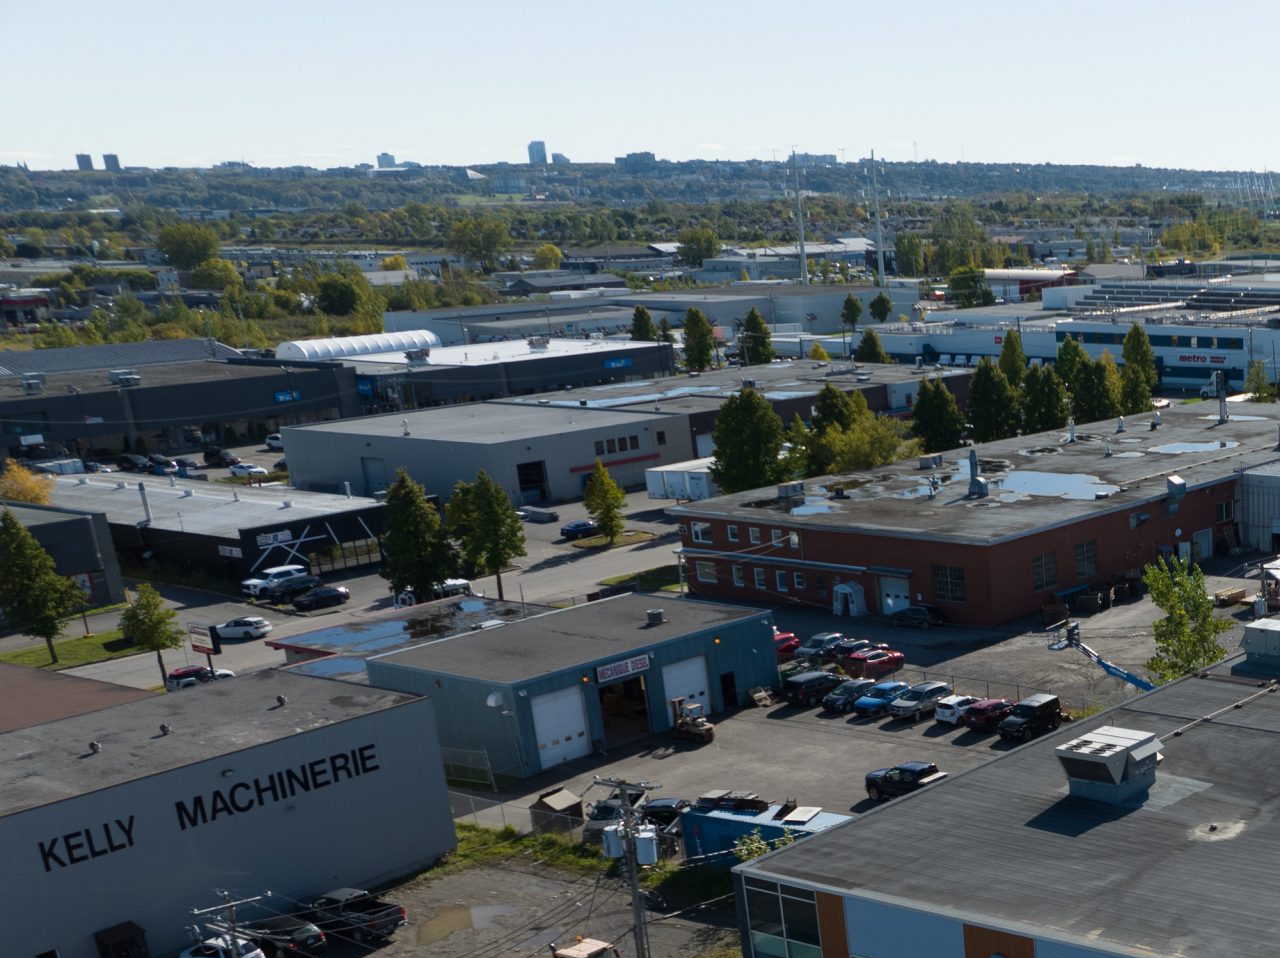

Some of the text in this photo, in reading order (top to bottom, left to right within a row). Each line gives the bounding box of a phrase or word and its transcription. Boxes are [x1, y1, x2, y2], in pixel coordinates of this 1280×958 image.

[1179, 354, 1207, 363] metro
[630, 656, 648, 671] DIESEL
[38, 744, 380, 872] KELLY MACHINERIE
